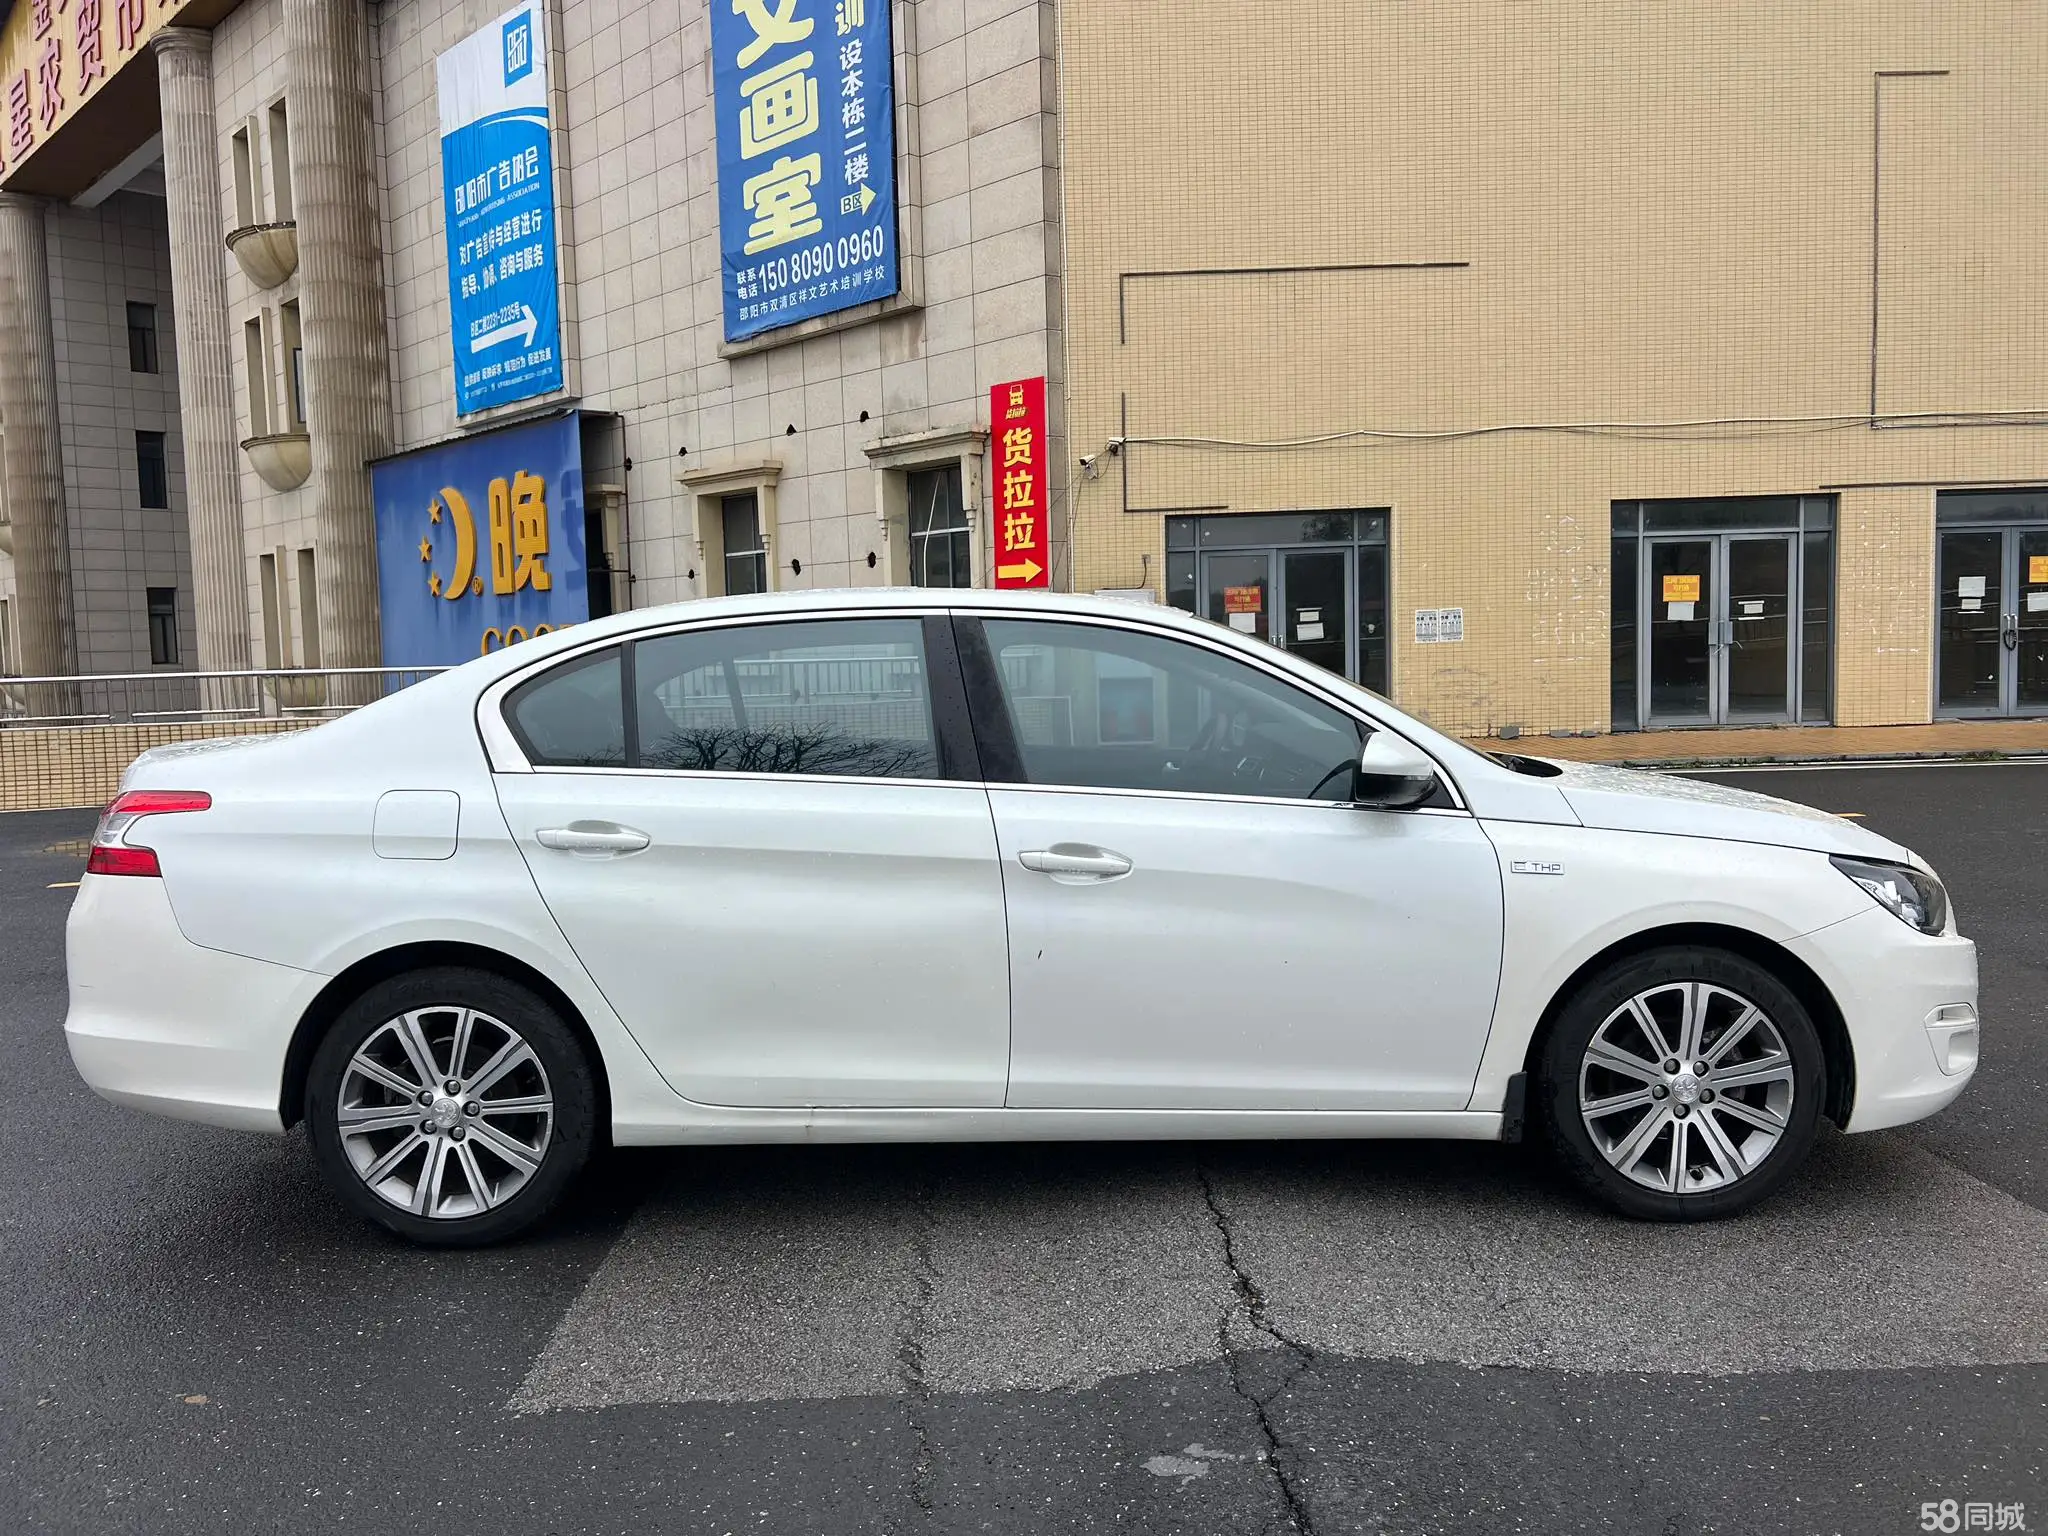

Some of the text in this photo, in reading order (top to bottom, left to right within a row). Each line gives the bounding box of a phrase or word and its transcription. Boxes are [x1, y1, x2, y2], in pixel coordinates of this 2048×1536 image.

[839, 38, 870, 186] 设本栋二楼
[454, 145, 539, 215] 邵阳市广告协会
[459, 208, 543, 266] 对广告宣传与经营进行
[758, 224, 884, 294] 150 8090 0960
[737, 268, 756, 285] 联系
[737, 283, 759, 300] 电话
[739, 264, 885, 321] 邵阳市双清区祥文艺术培训学校
[1002, 426, 1036, 552] 货拉拉
[488, 468, 552, 595] 晚
[1531, 863, 1561, 872] THP
